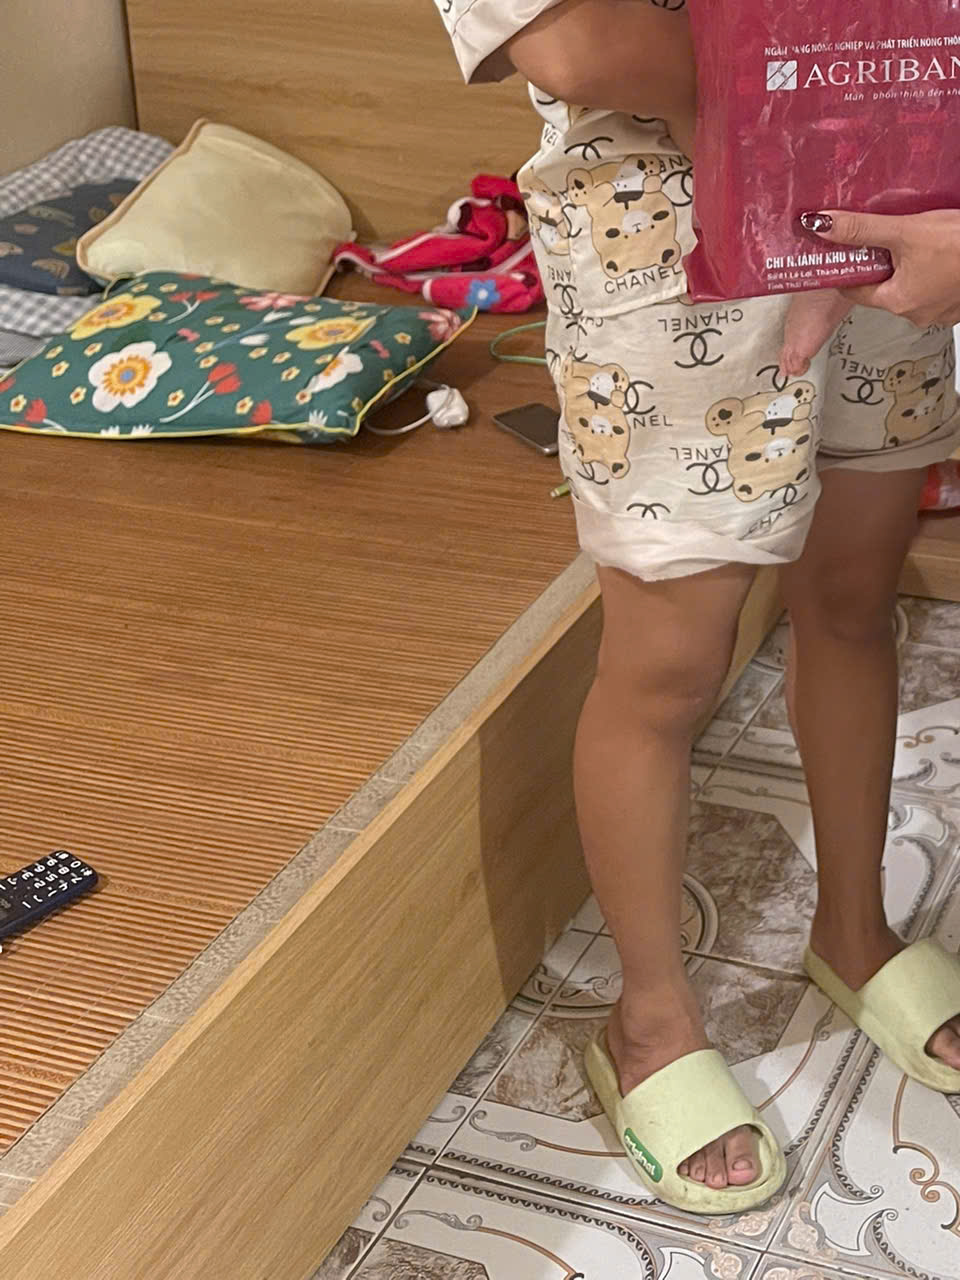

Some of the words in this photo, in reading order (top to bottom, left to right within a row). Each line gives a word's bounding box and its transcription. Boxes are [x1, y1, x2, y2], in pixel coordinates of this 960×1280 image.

[766, 256, 784, 269] CHI
[825, 250, 846, 264] KHU
[604, 265, 682, 294] CHANEL
[658, 308, 744, 332] CHANEL
